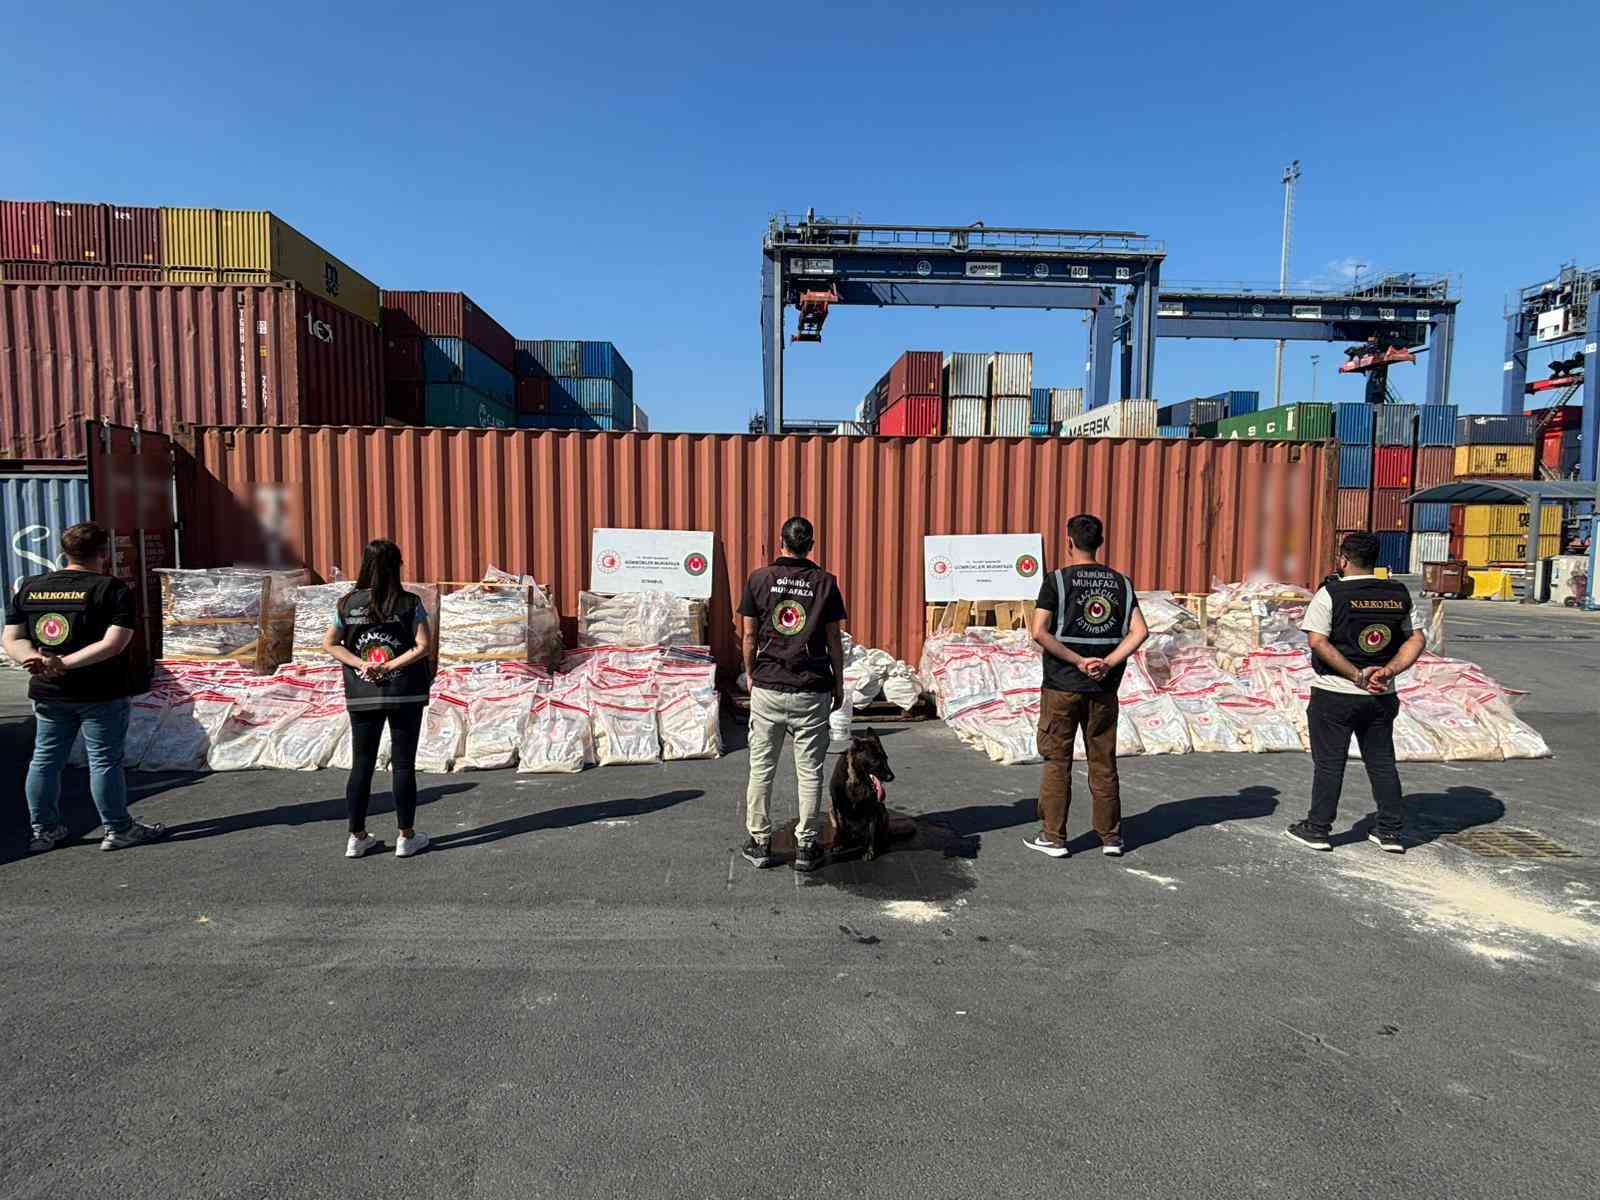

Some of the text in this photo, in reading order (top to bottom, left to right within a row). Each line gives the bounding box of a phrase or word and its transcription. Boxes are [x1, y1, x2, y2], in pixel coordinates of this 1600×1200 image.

[1069, 416, 1110, 437] MAERSK
[1072, 579, 1119, 590] MUHAFAZA
[1349, 598, 1404, 609] NARKOKİM
